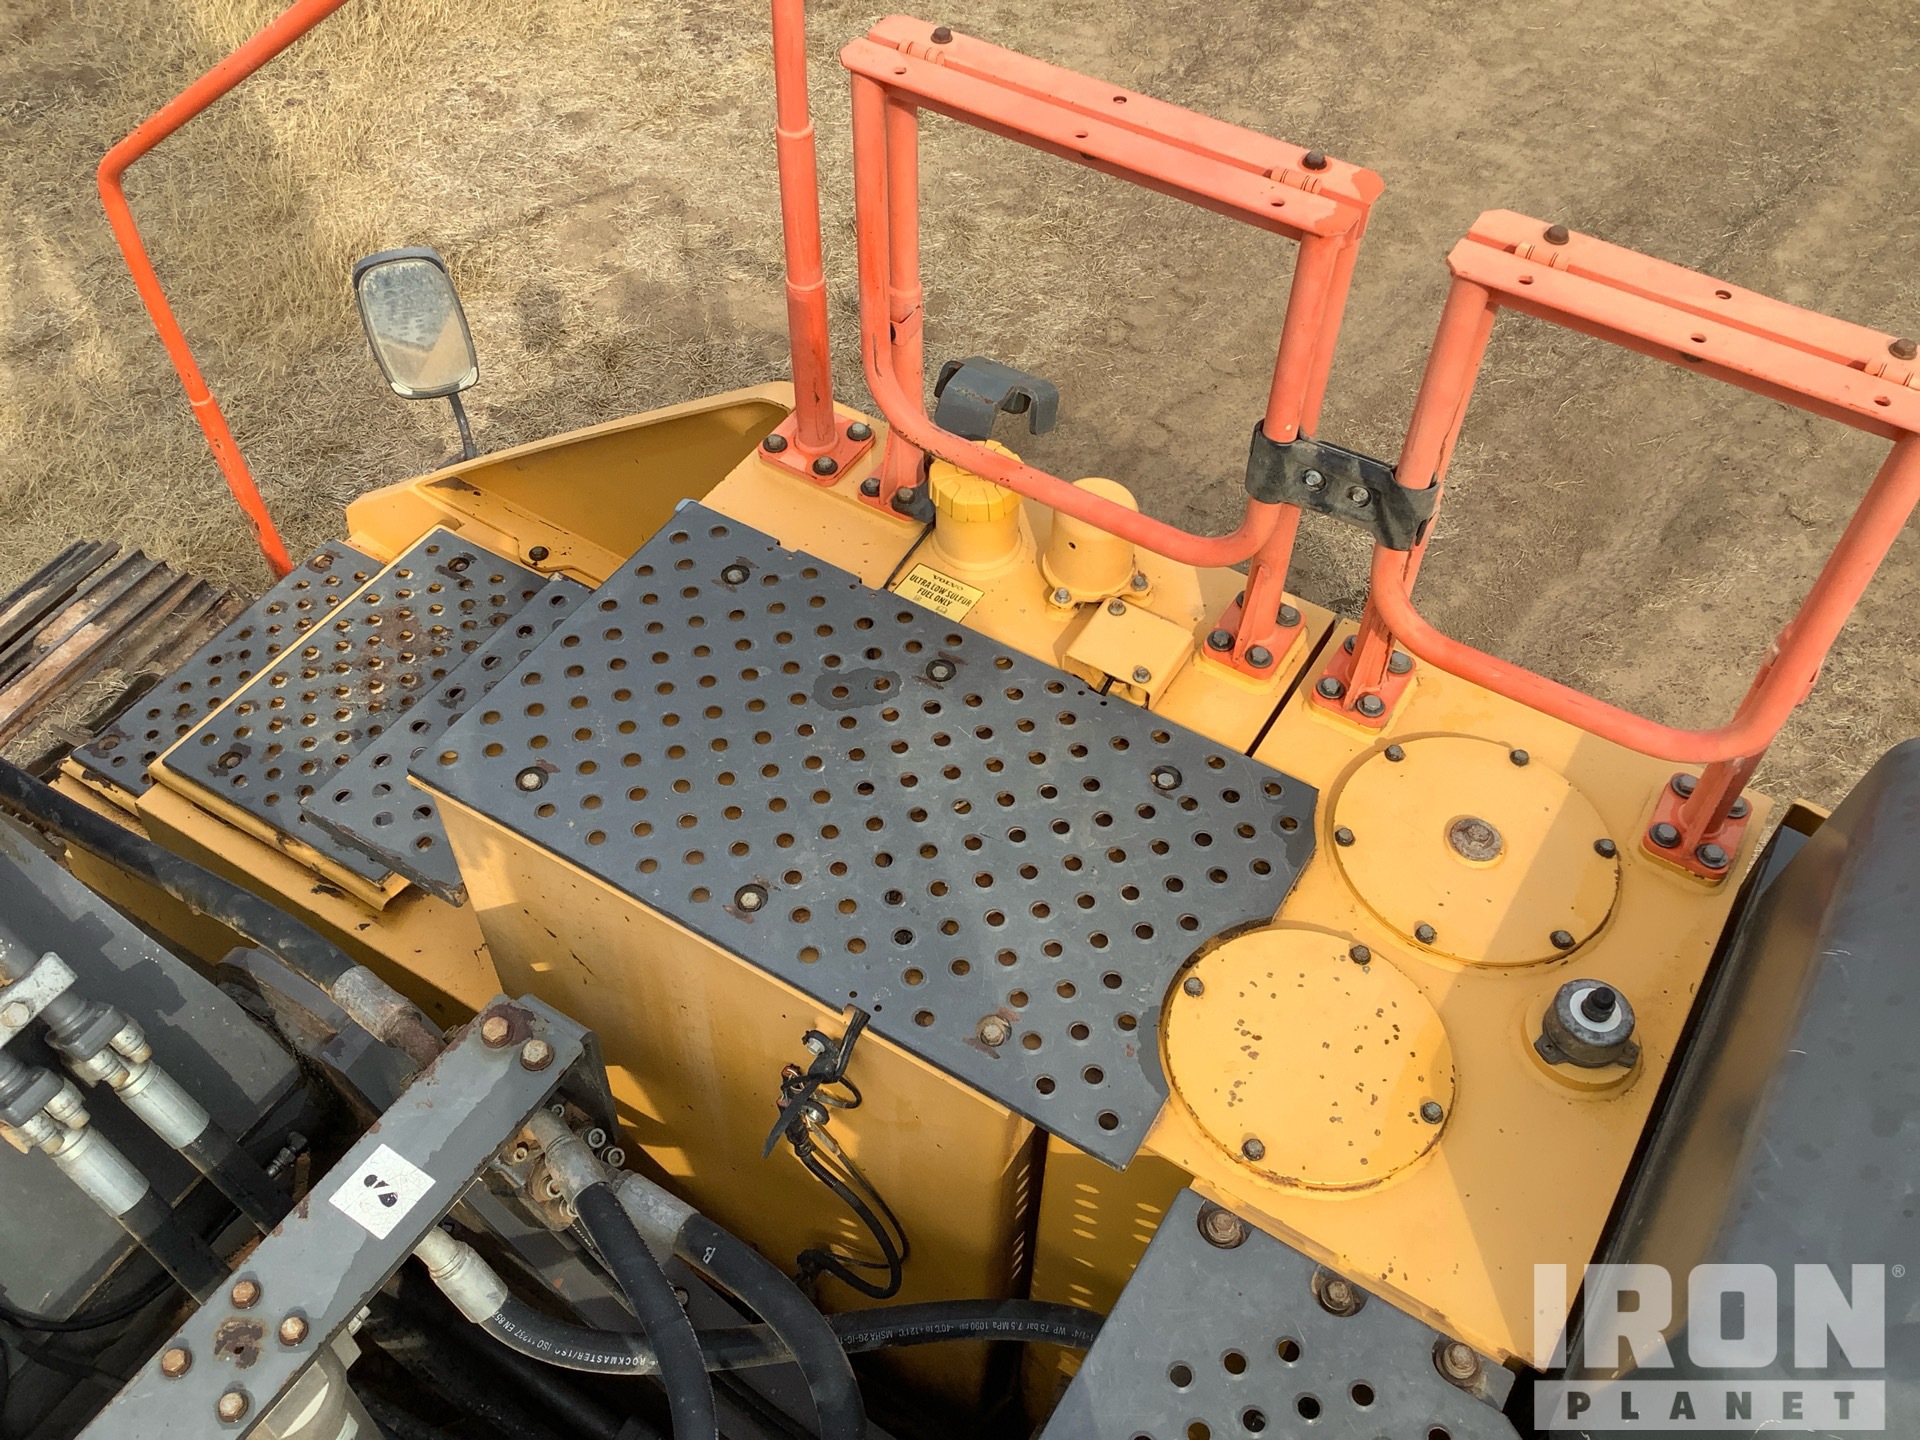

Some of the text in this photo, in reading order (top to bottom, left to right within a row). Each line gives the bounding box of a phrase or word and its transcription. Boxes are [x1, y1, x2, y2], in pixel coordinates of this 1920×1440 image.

[932, 573, 964, 591] VOLVO
[909, 574, 973, 607] ULTRA LOW SULFUR
[916, 587, 953, 607] FUEL ONLY
[502, 1320, 516, 1332] EN
[970, 1321, 988, 1331] 1090
[992, 1321, 1009, 1331] MPa
[1010, 1321, 1023, 1331] 7.5
[1026, 1322, 1039, 1332] bar
[1040, 1323, 1050, 1333] 75
[1053, 1326, 1066, 1335] WP
[870, 1329, 893, 1341] MSHA
[536, 1339, 552, 1352] ISO
